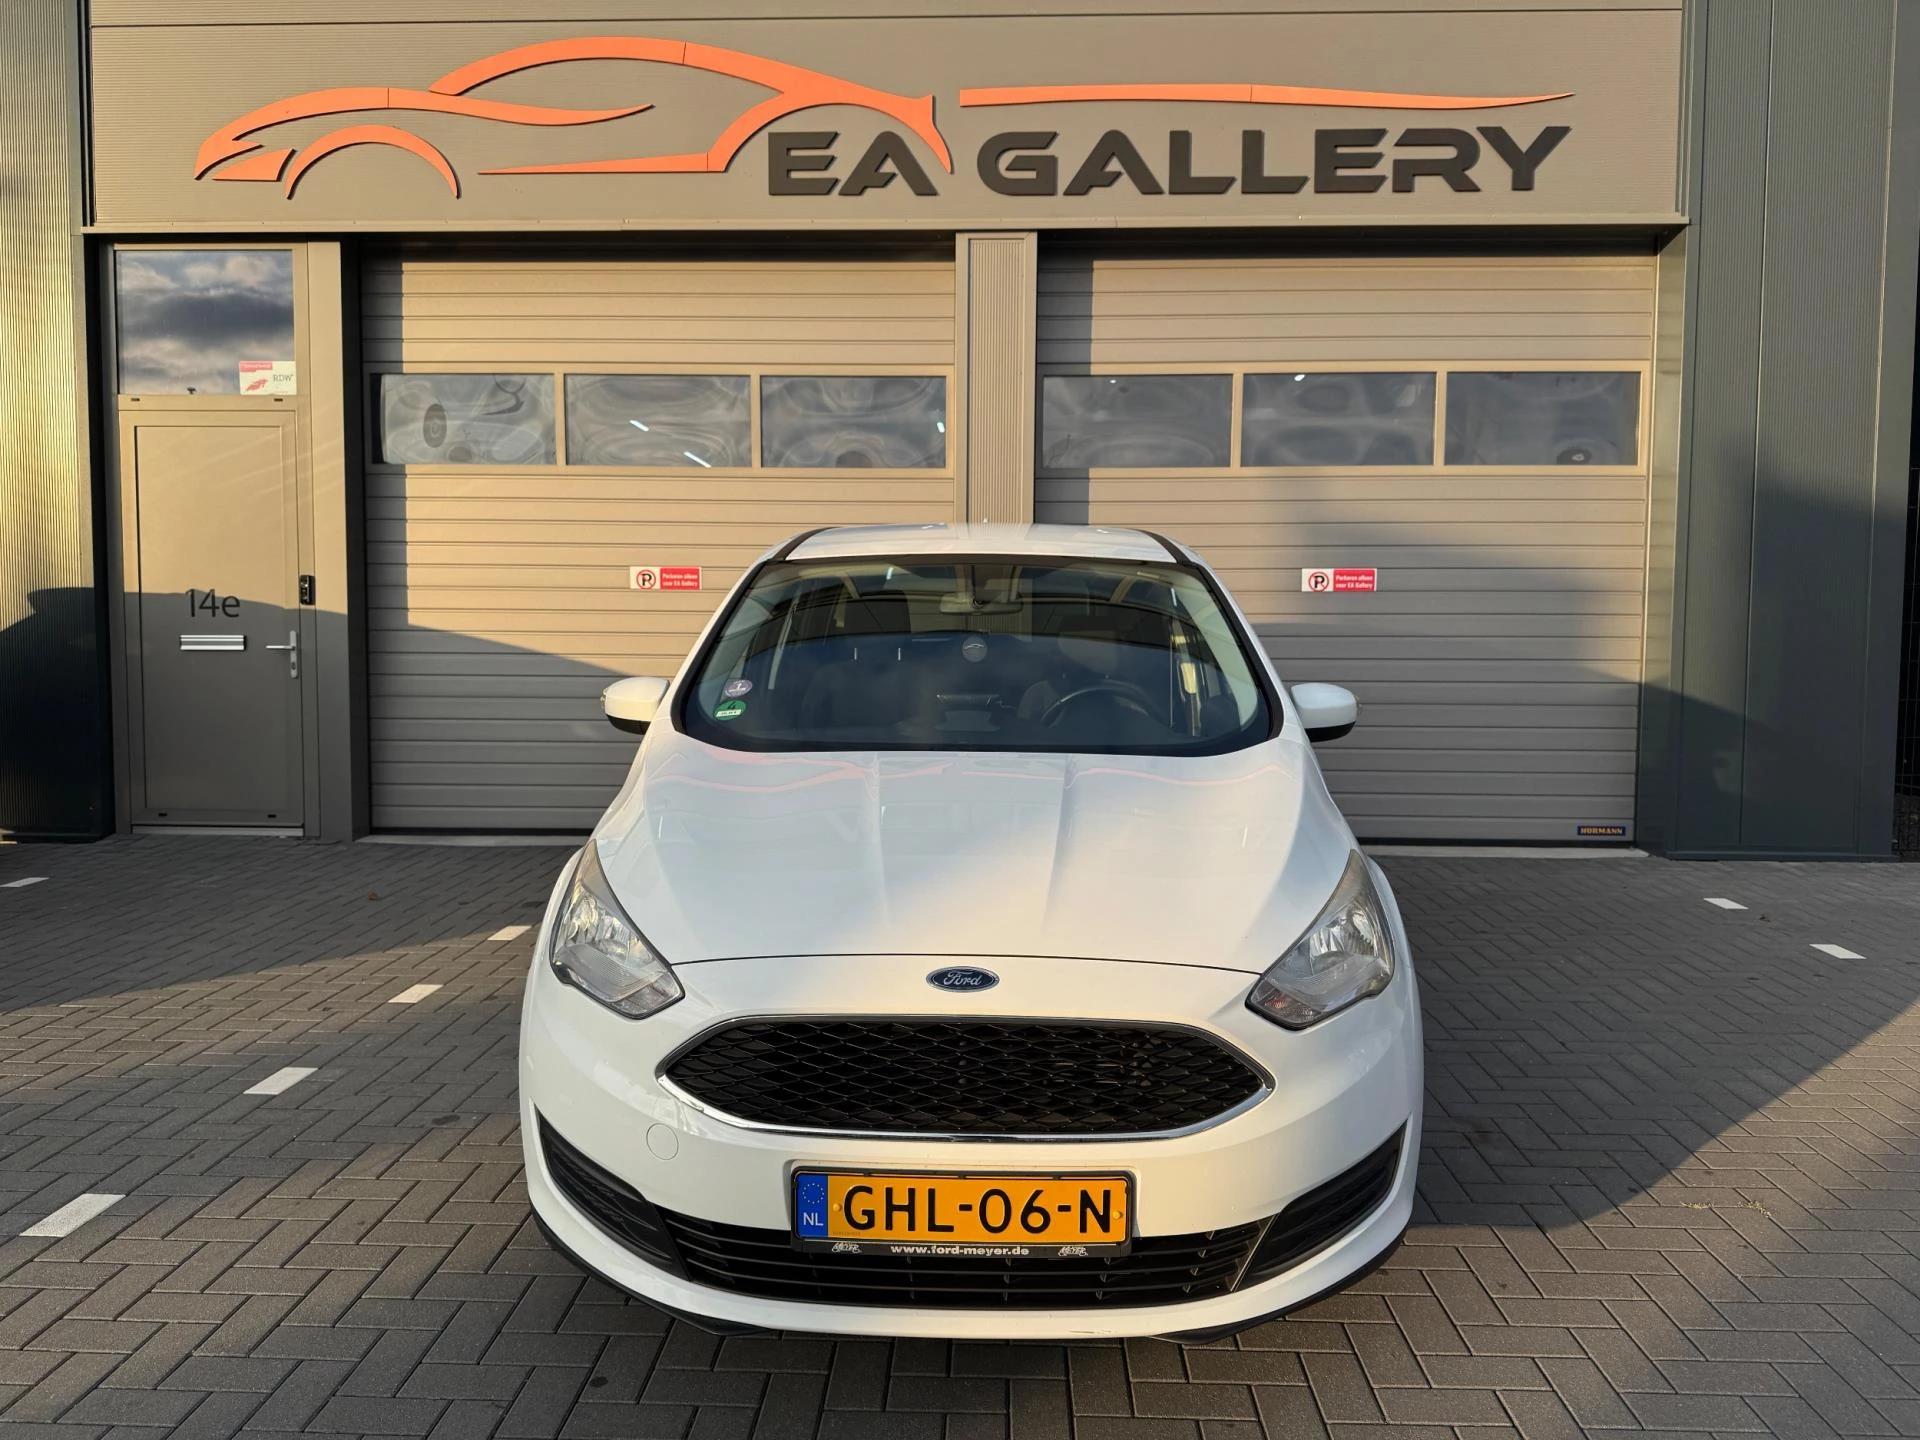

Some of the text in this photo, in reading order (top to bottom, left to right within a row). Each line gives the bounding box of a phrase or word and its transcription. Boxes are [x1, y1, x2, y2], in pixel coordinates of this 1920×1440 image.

[768, 126, 1572, 197] EA GALLERY
[185, 588, 241, 618] 14e
[943, 969, 983, 986] Ford
[803, 1211, 824, 1227] NL
[843, 1185, 1111, 1234] GHL-06-N
[890, 1245, 1030, 1257] www.ford-meyer.de
